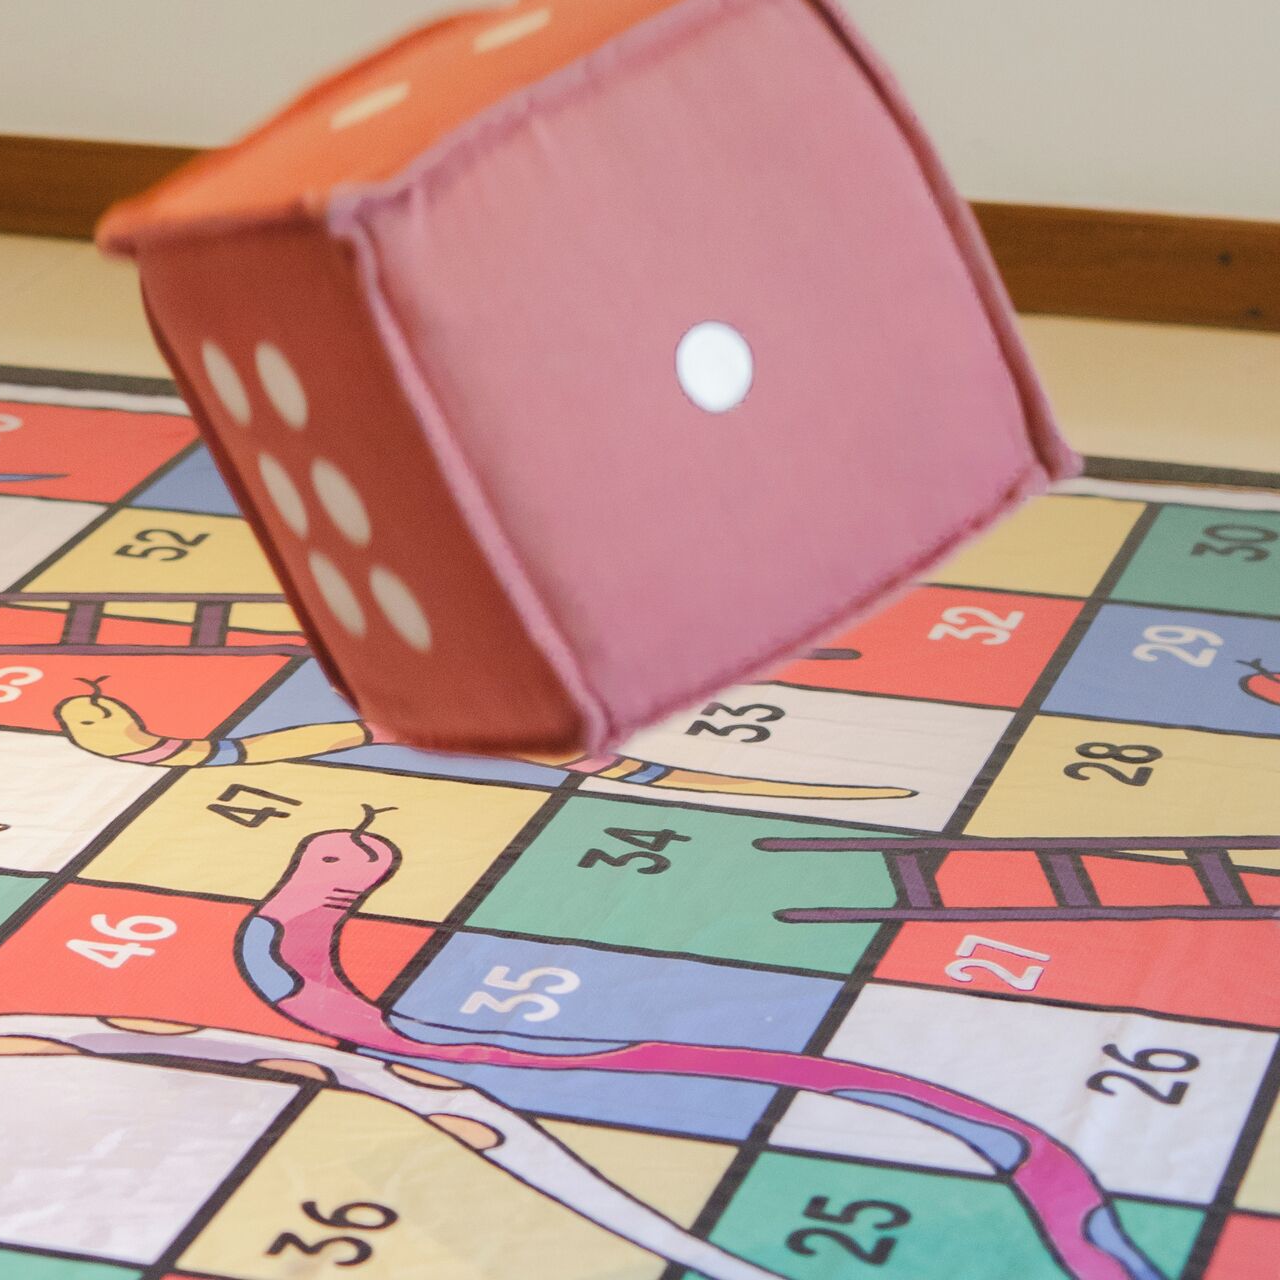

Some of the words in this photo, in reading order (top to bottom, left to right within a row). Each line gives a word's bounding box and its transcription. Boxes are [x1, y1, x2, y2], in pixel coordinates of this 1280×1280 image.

[114, 528, 210, 562] 52
[1190, 522, 1277, 563] 30
[927, 606, 1024, 646] 32
[1132, 624, 1224, 668] 29
[684, 701, 786, 744] 33
[1063, 741, 1163, 787] 28
[206, 783, 303, 828] 47
[578, 826, 692, 875] 34
[65, 913, 178, 969] 46
[944, 934, 1051, 991] 27
[460, 965, 582, 1022] 35
[1085, 1043, 1201, 1107] 26
[264, 1200, 400, 1266] 36
[785, 1196, 912, 1266] 25
